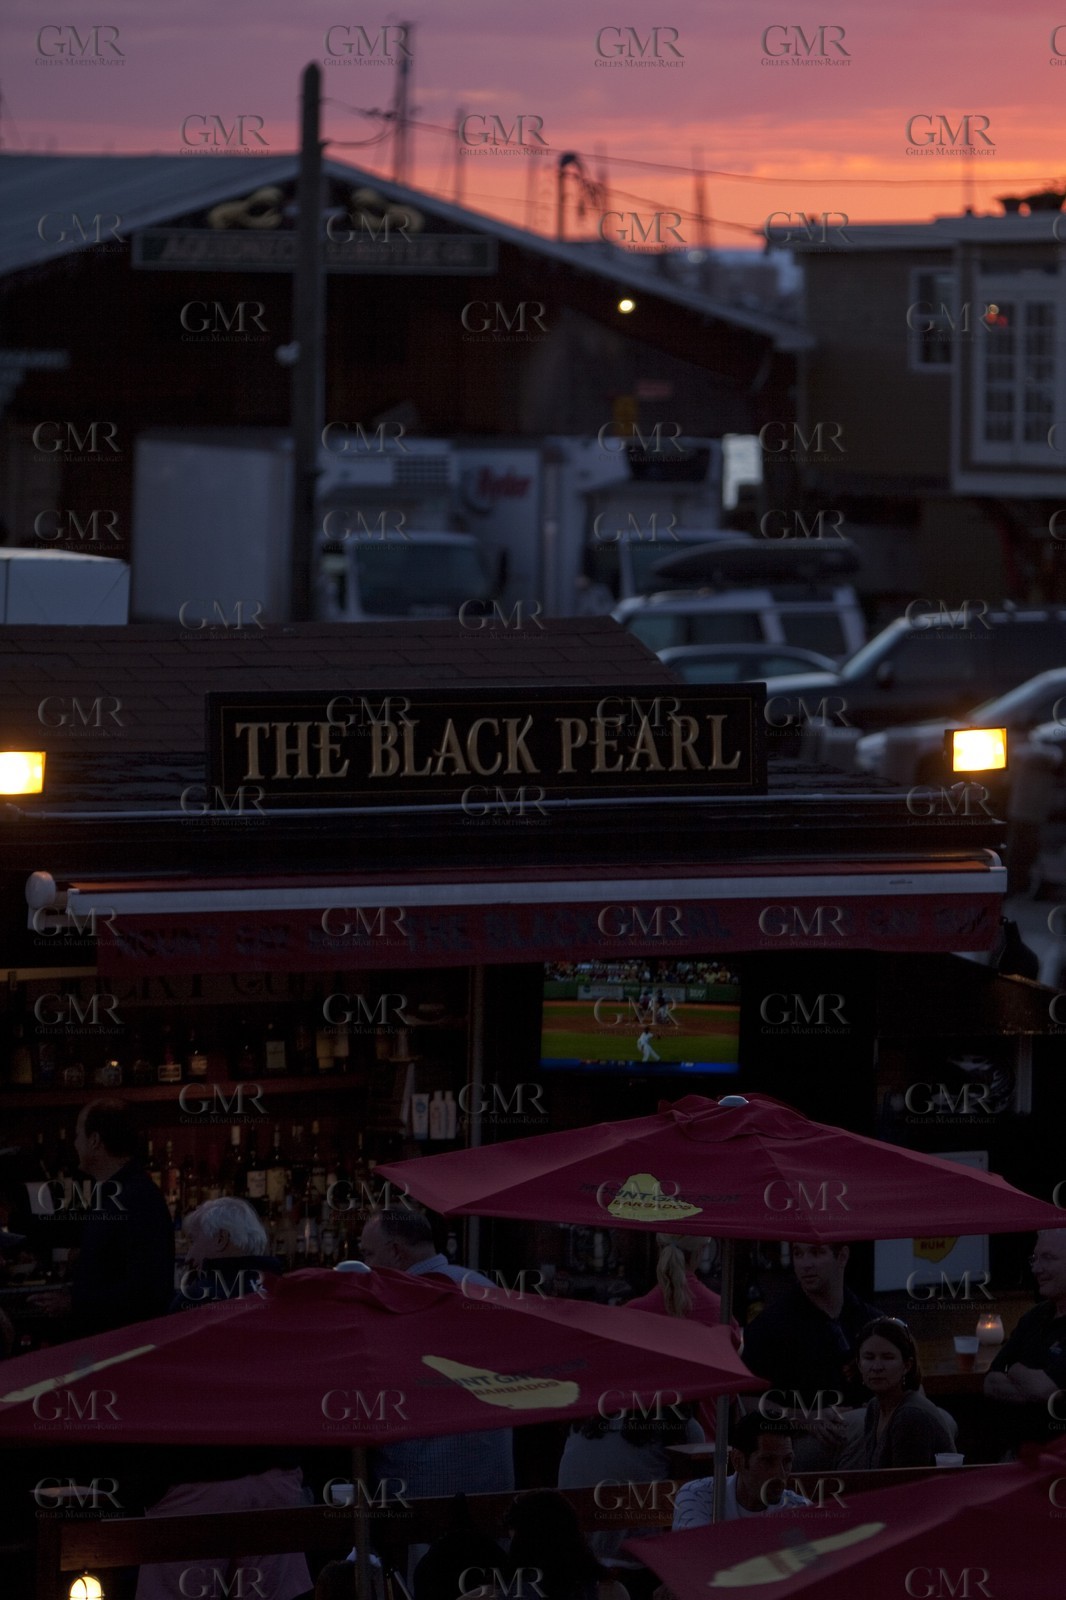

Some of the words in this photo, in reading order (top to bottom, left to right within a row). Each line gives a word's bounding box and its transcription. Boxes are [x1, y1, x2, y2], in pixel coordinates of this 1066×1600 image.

[235, 721, 350, 780] THE
[368, 714, 541, 779] BLACK
[555, 714, 741, 775] PEARL
[920, 1240, 945, 1249] RUM
